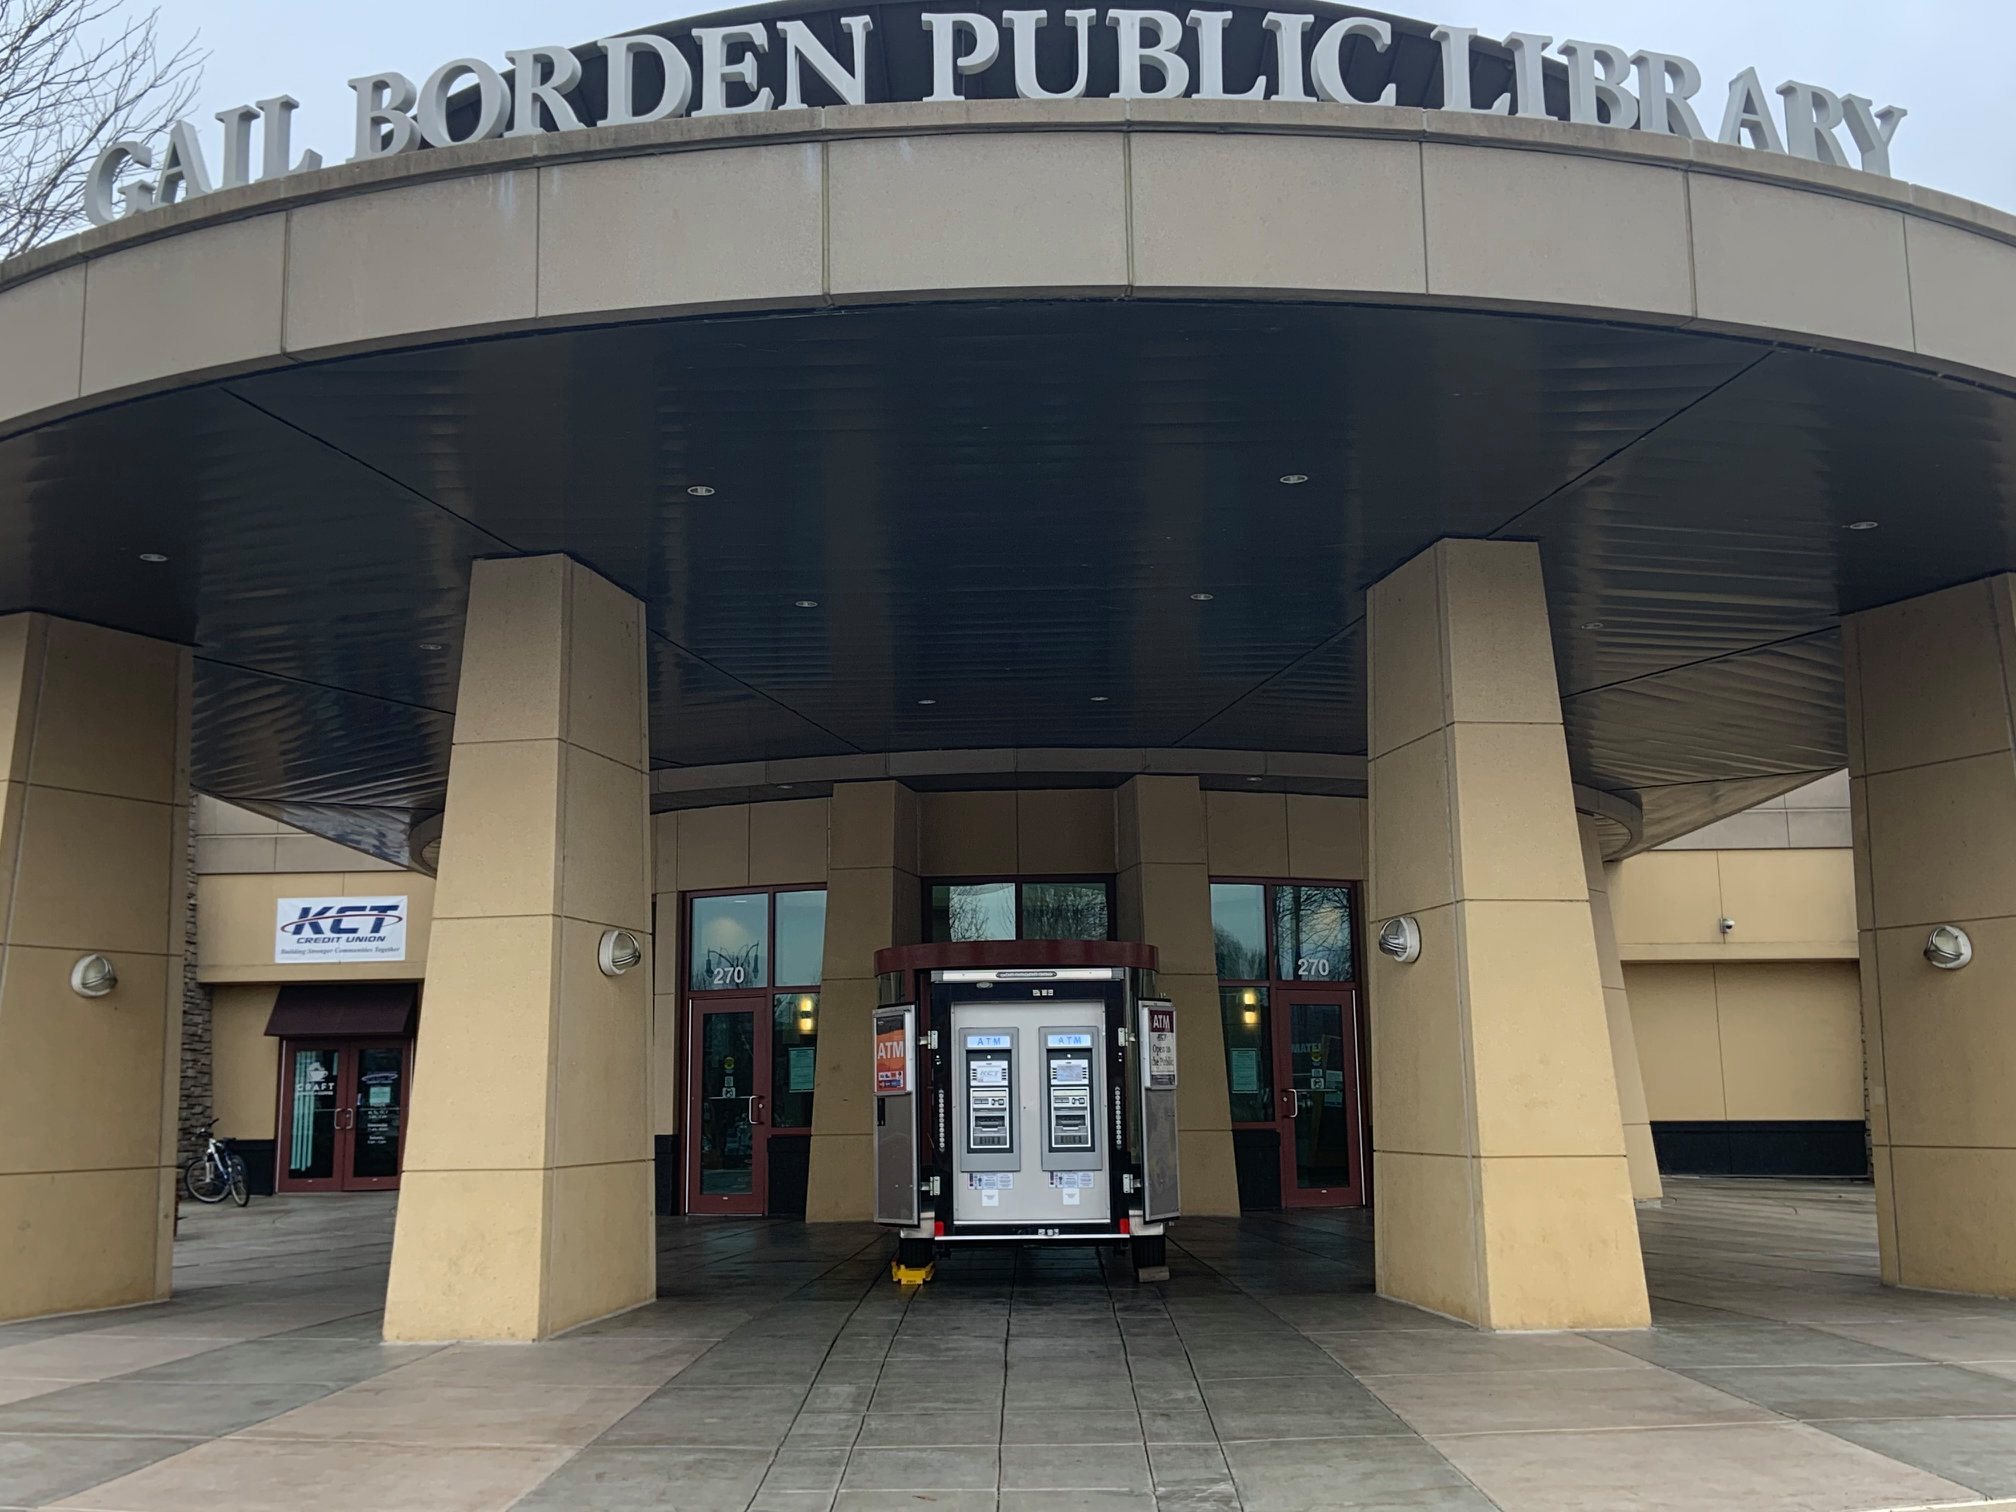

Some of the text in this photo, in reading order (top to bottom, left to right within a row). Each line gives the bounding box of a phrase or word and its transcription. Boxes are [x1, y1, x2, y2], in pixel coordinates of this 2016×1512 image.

[85, 8, 1908, 228] GAIL BORDEN PUBLIC LIBRARY
[291, 905, 400, 935] KCT
[296, 936, 342, 944] CREDIT
[713, 966, 745, 984] 270
[1297, 958, 1330, 976] 270
[1153, 1014, 1170, 1030] ATM
[977, 1037, 1001, 1046] ATM
[1058, 1036, 1082, 1044] ATM
[877, 1041, 904, 1059] ATM
[296, 1082, 335, 1091] CRAFT
